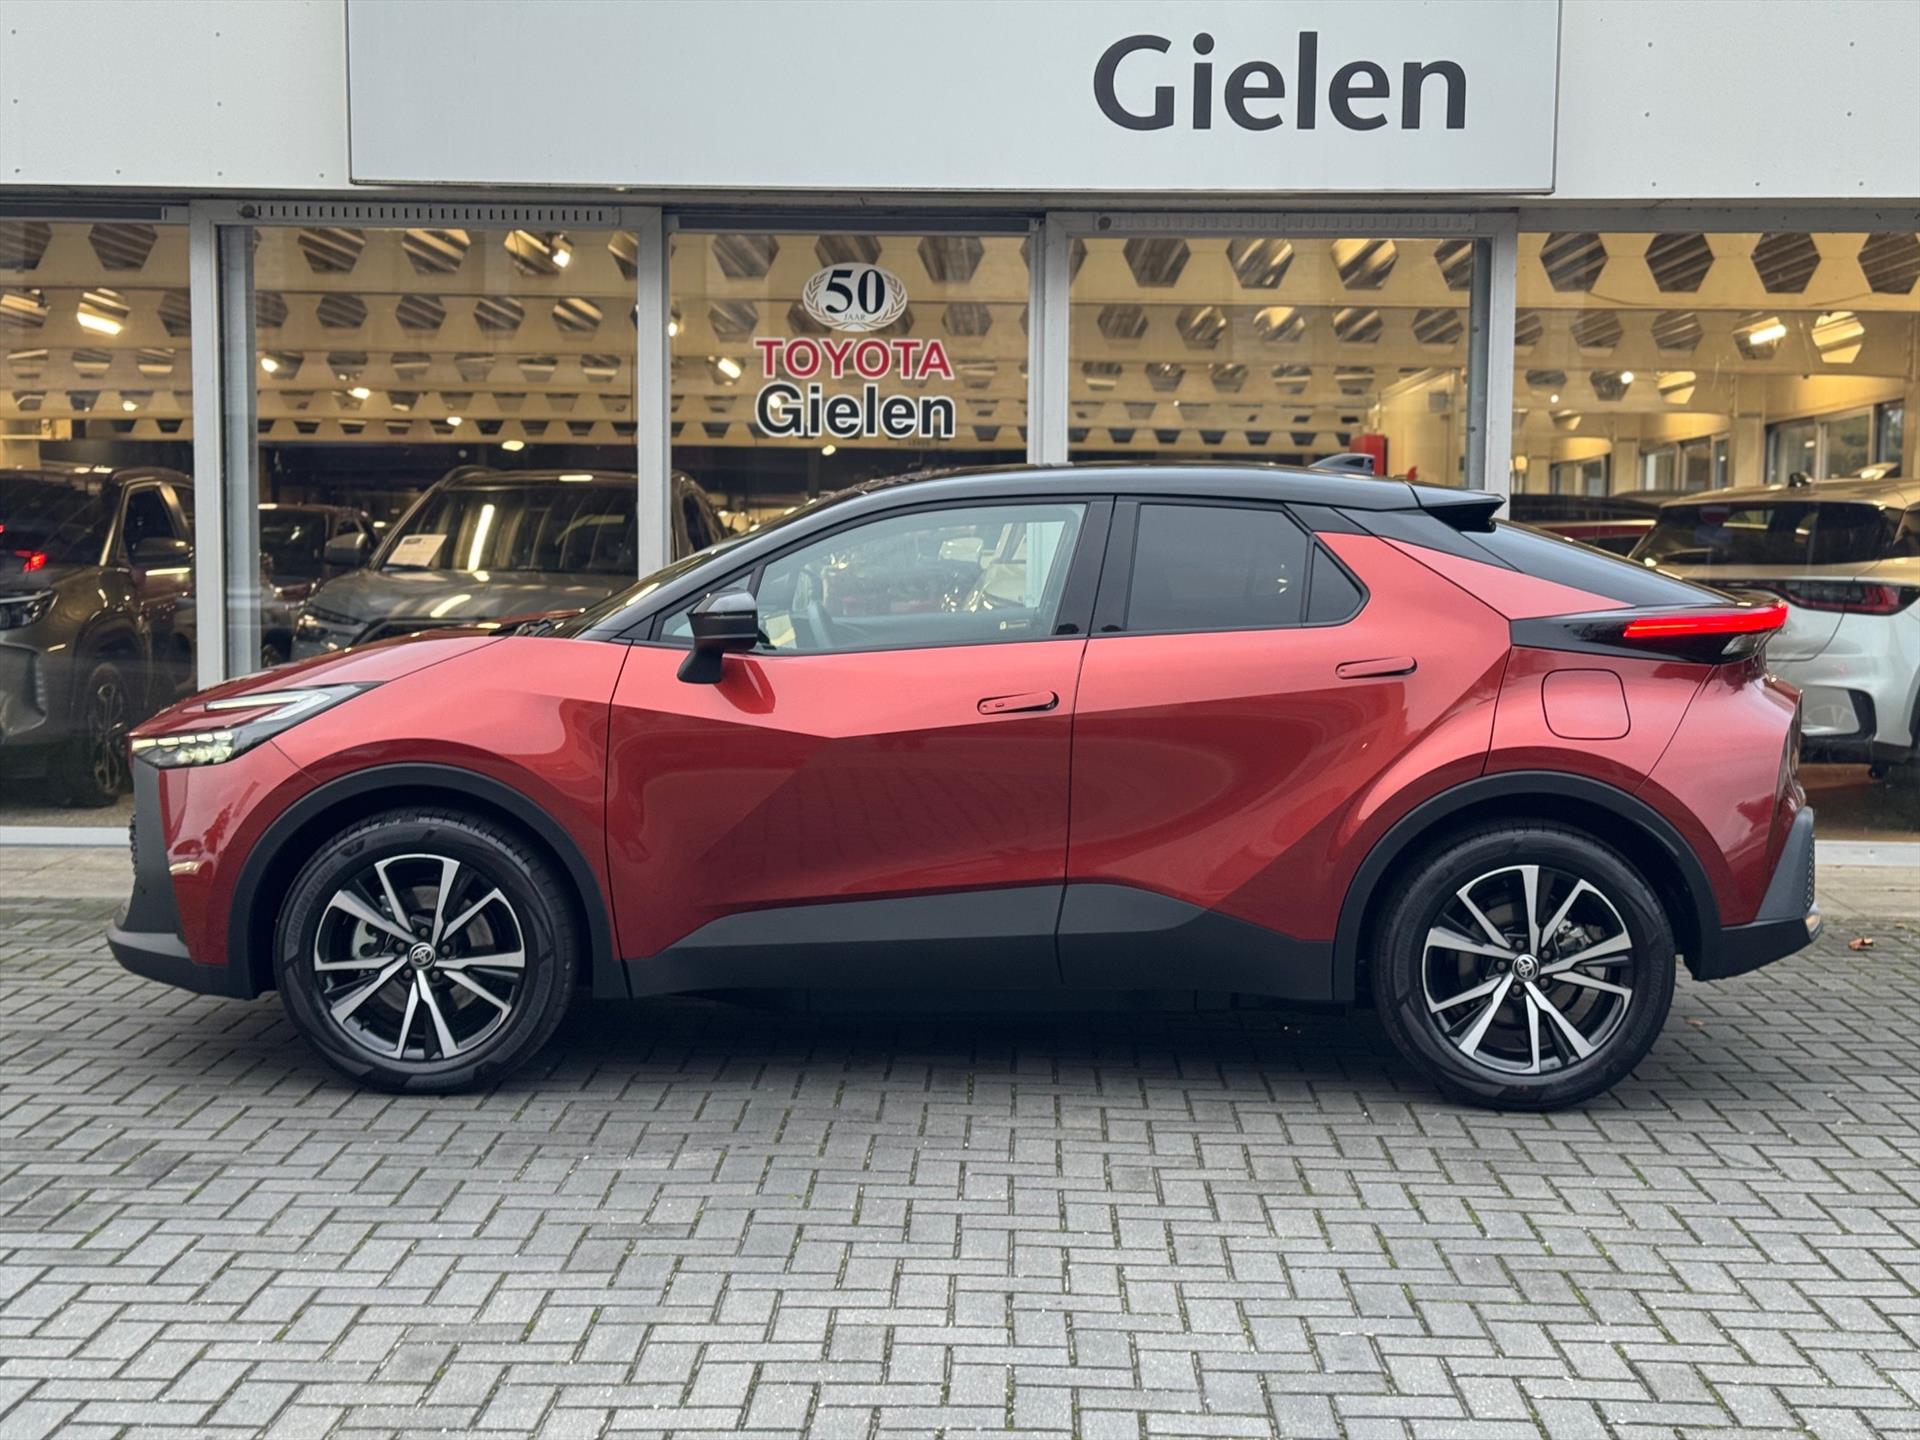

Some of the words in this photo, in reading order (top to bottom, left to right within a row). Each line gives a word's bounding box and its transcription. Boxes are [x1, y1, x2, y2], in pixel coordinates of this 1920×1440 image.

[1093, 31, 1467, 132] Gielen
[825, 269, 886, 314] 50
[843, 313, 867, 321] JAAR
[754, 338, 955, 380] TOYOTA
[756, 382, 956, 438] Gielen
